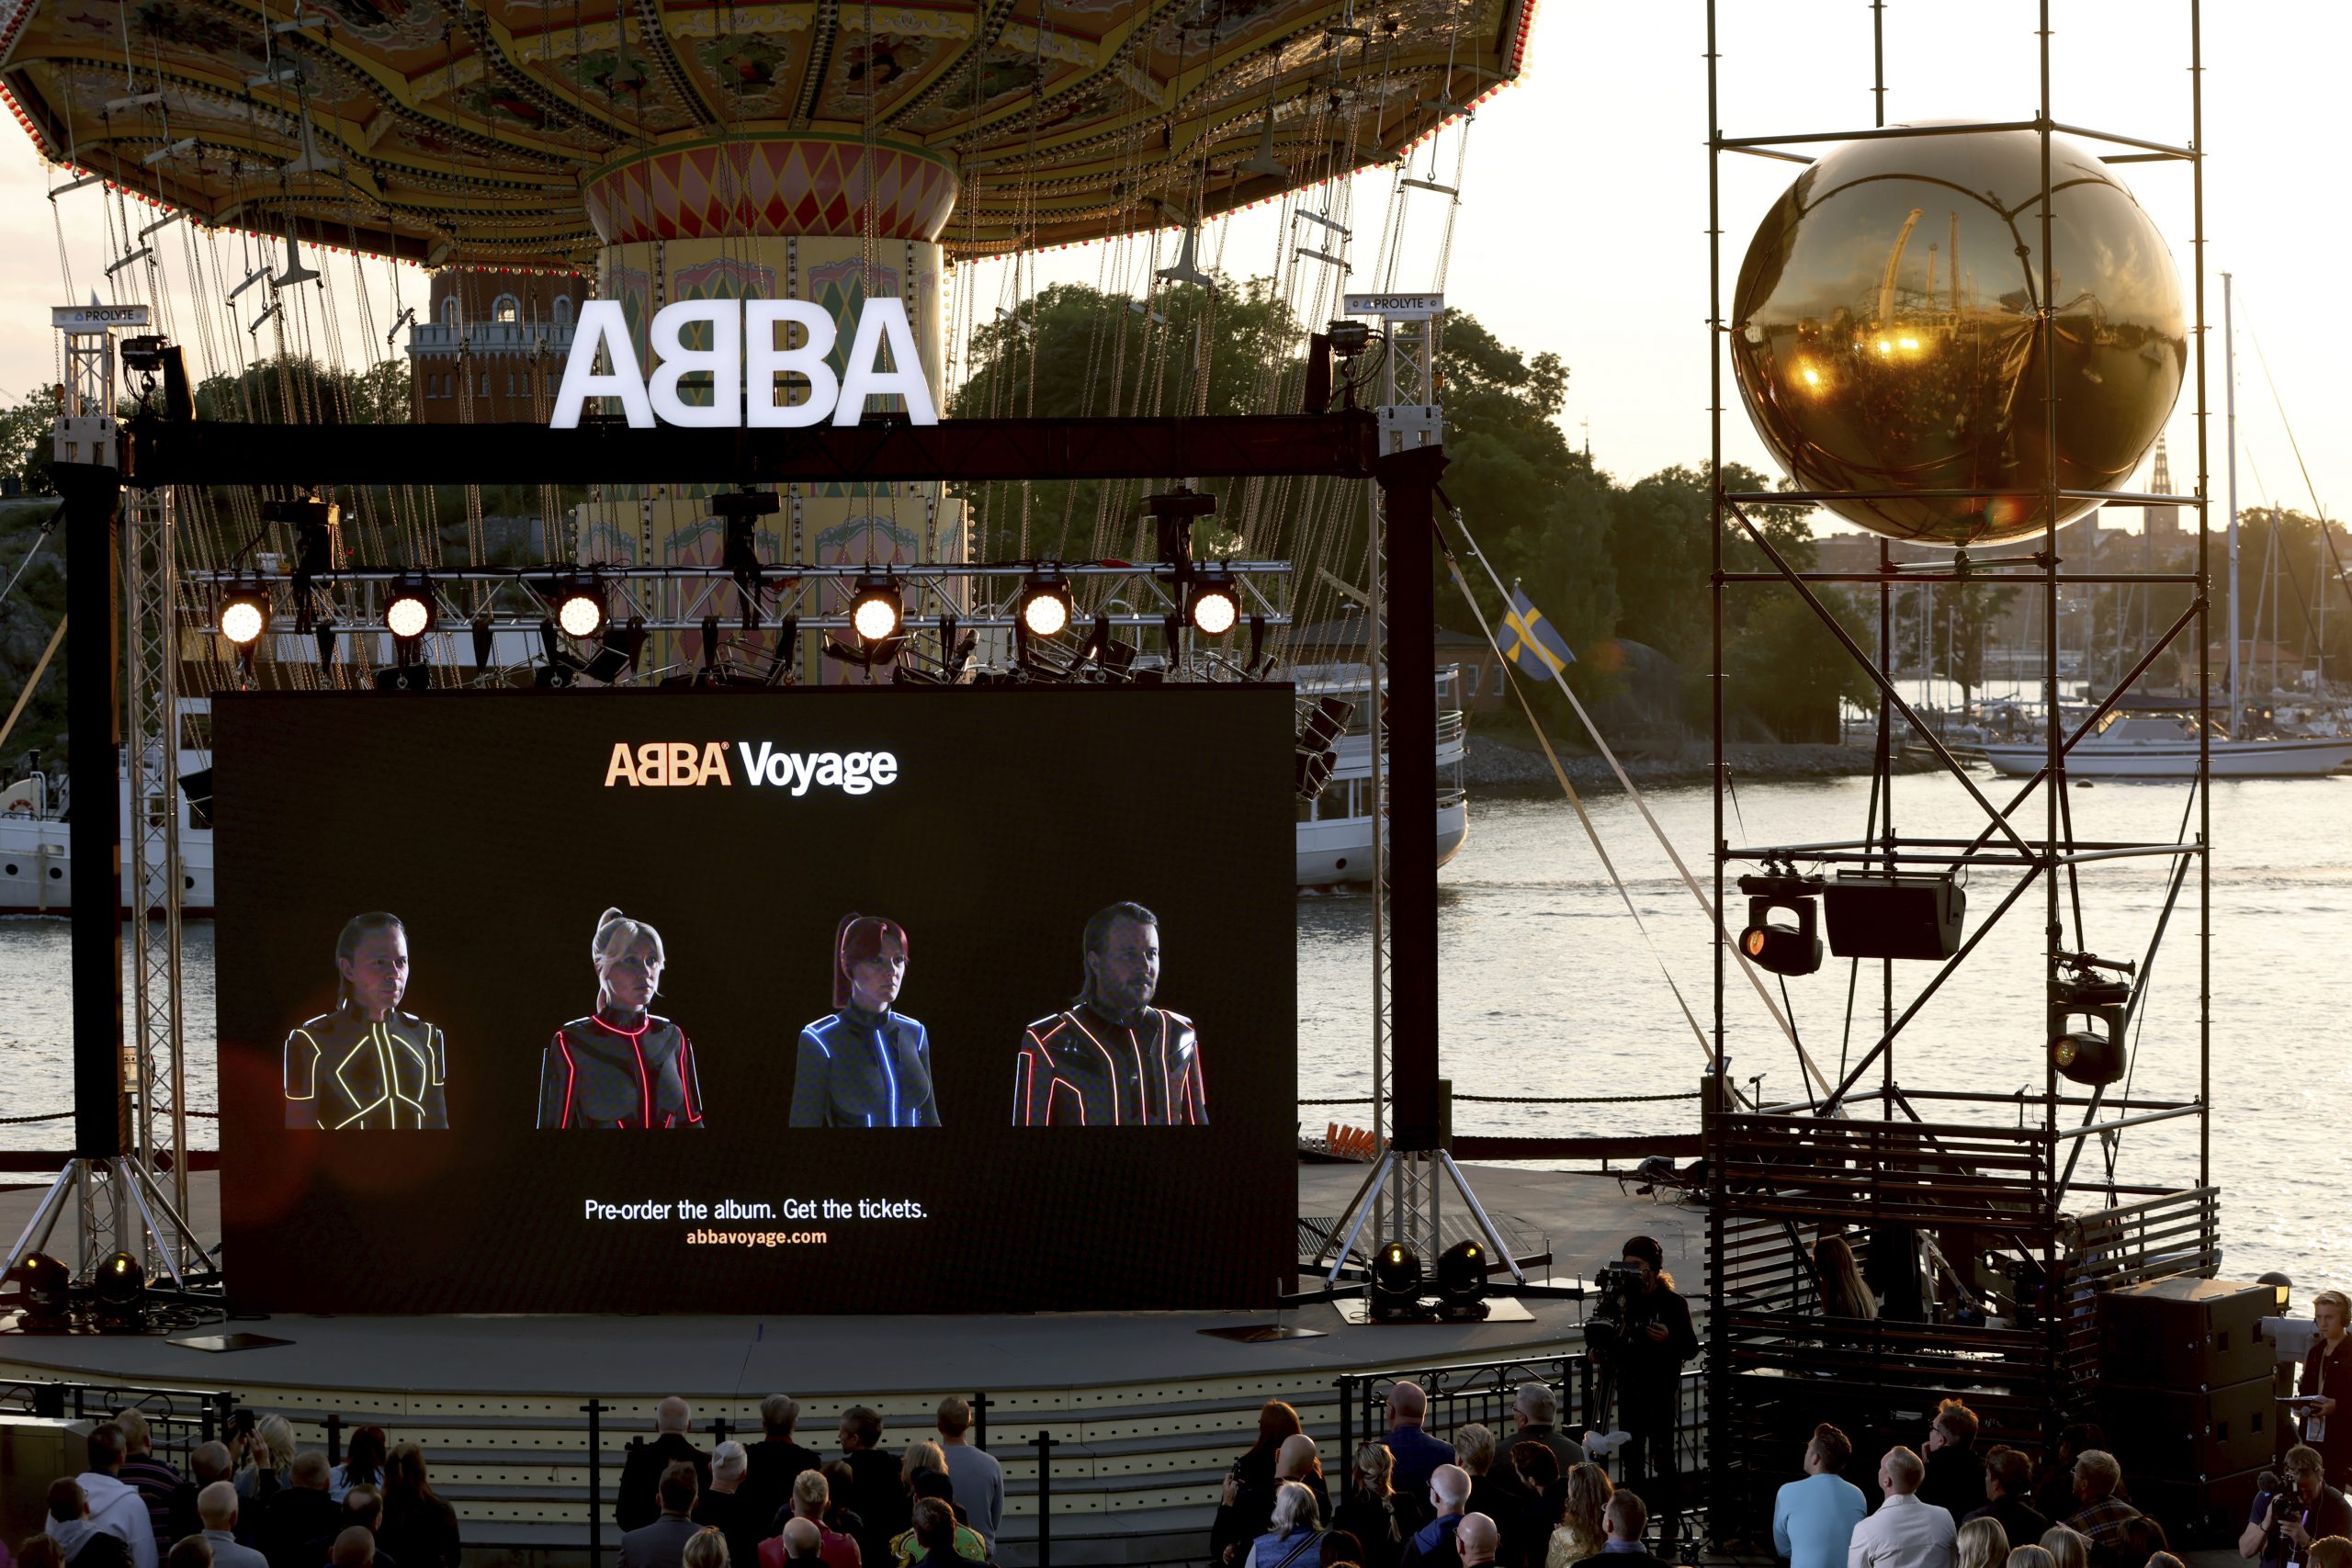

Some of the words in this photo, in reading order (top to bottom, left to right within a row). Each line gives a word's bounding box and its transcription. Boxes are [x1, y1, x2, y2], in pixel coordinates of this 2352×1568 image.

[1374, 298, 1423, 309] PROLYTE
[85, 310, 134, 321] PROLYTE
[549, 297, 939, 429] ABBA
[738, 741, 898, 797] Voyage
[585, 1199, 673, 1220] Pre-order
[677, 1199, 708, 1220] the
[714, 1199, 776, 1220] album.
[784, 1198, 818, 1220] Get
[822, 1198, 853, 1219] the
[858, 1198, 928, 1219] tickets.
[686, 1229, 827, 1247] abbavoyage.com
